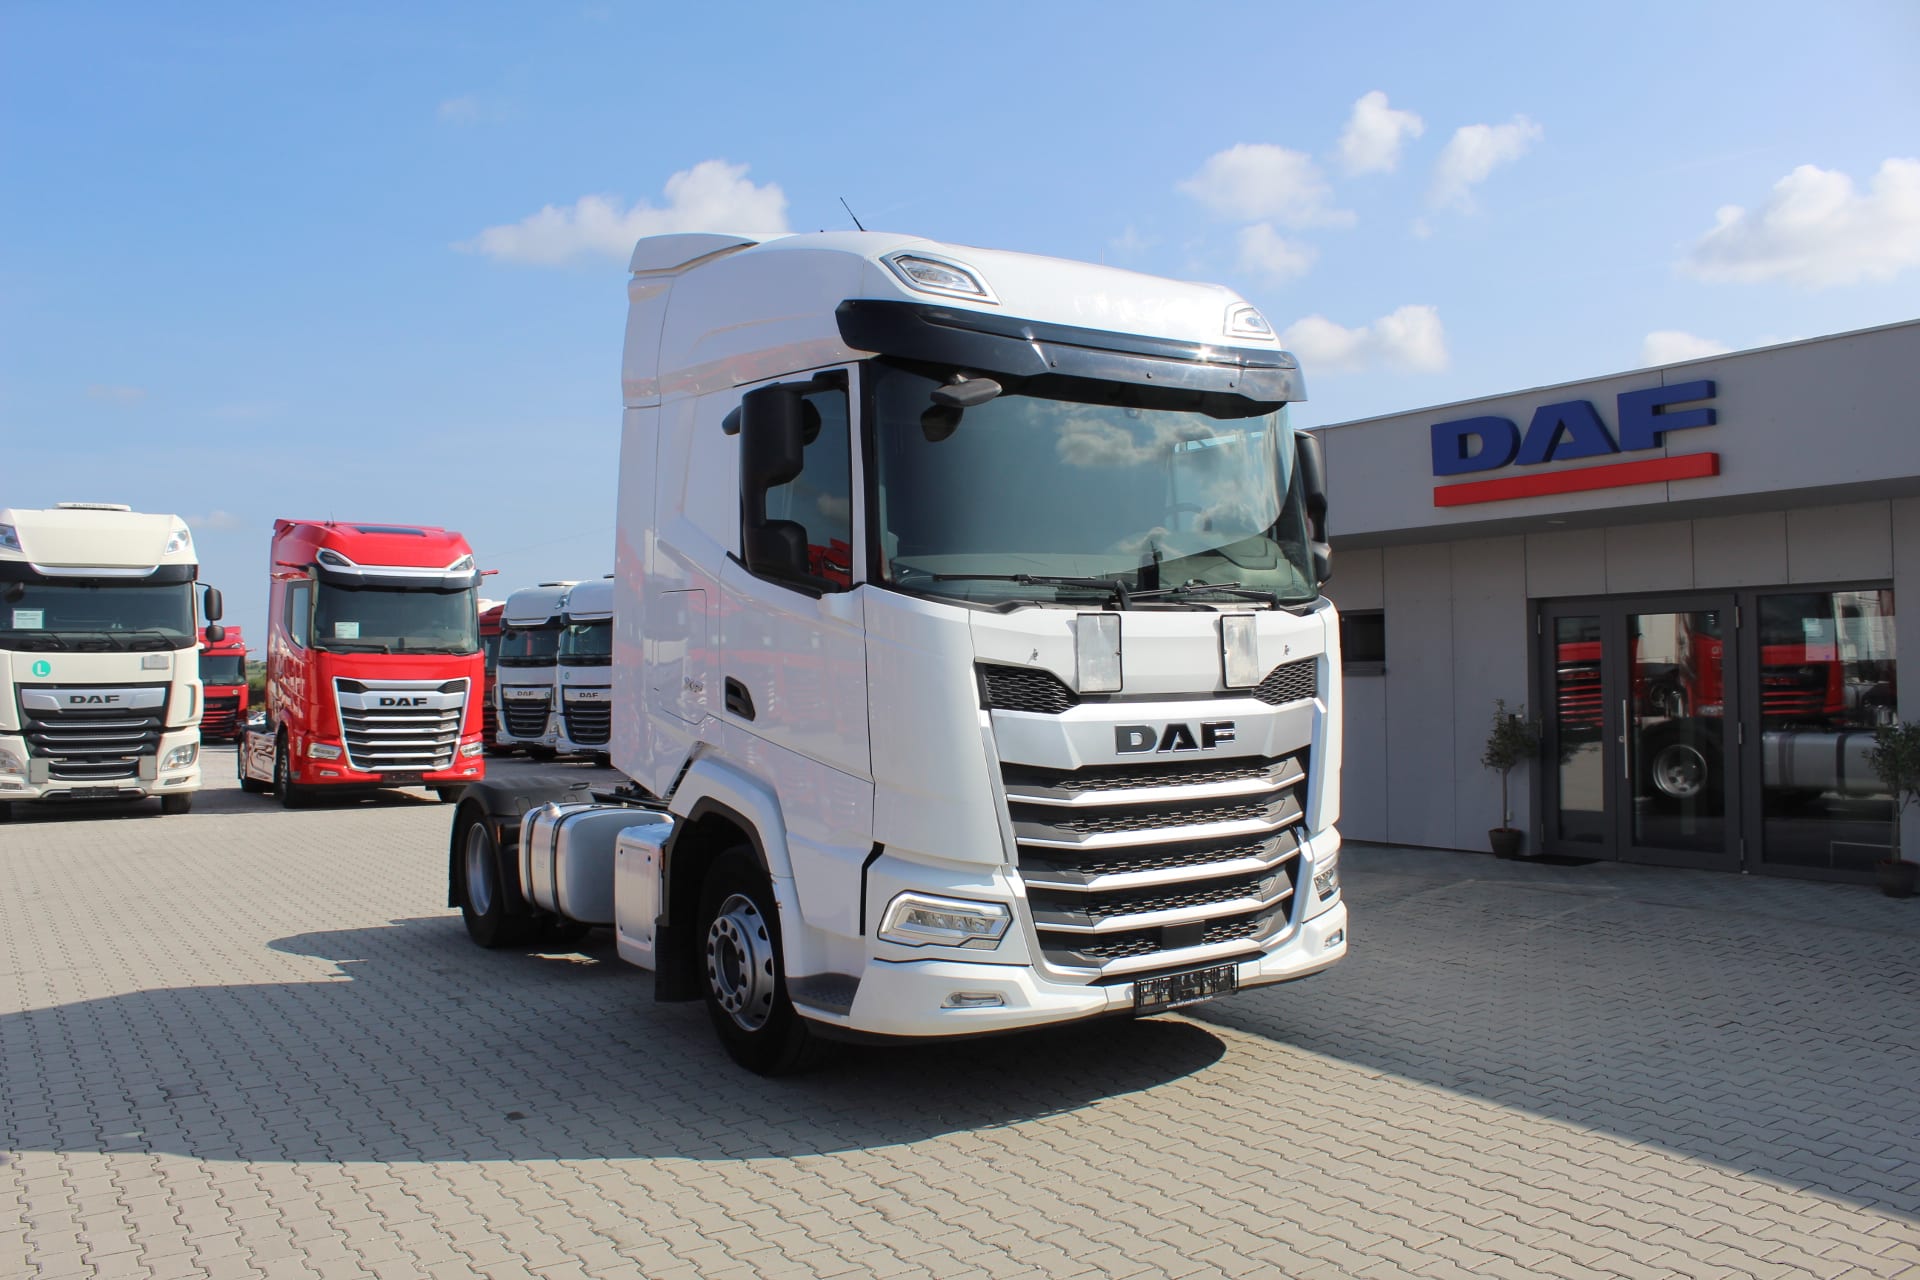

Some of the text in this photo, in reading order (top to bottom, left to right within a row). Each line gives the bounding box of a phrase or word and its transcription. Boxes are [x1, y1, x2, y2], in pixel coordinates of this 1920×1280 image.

[1431, 380, 1716, 476] DAF
[37, 663, 46, 675] L
[69, 695, 120, 704] DAF
[379, 697, 428, 706] DAF
[1114, 720, 1236, 755] DAF
